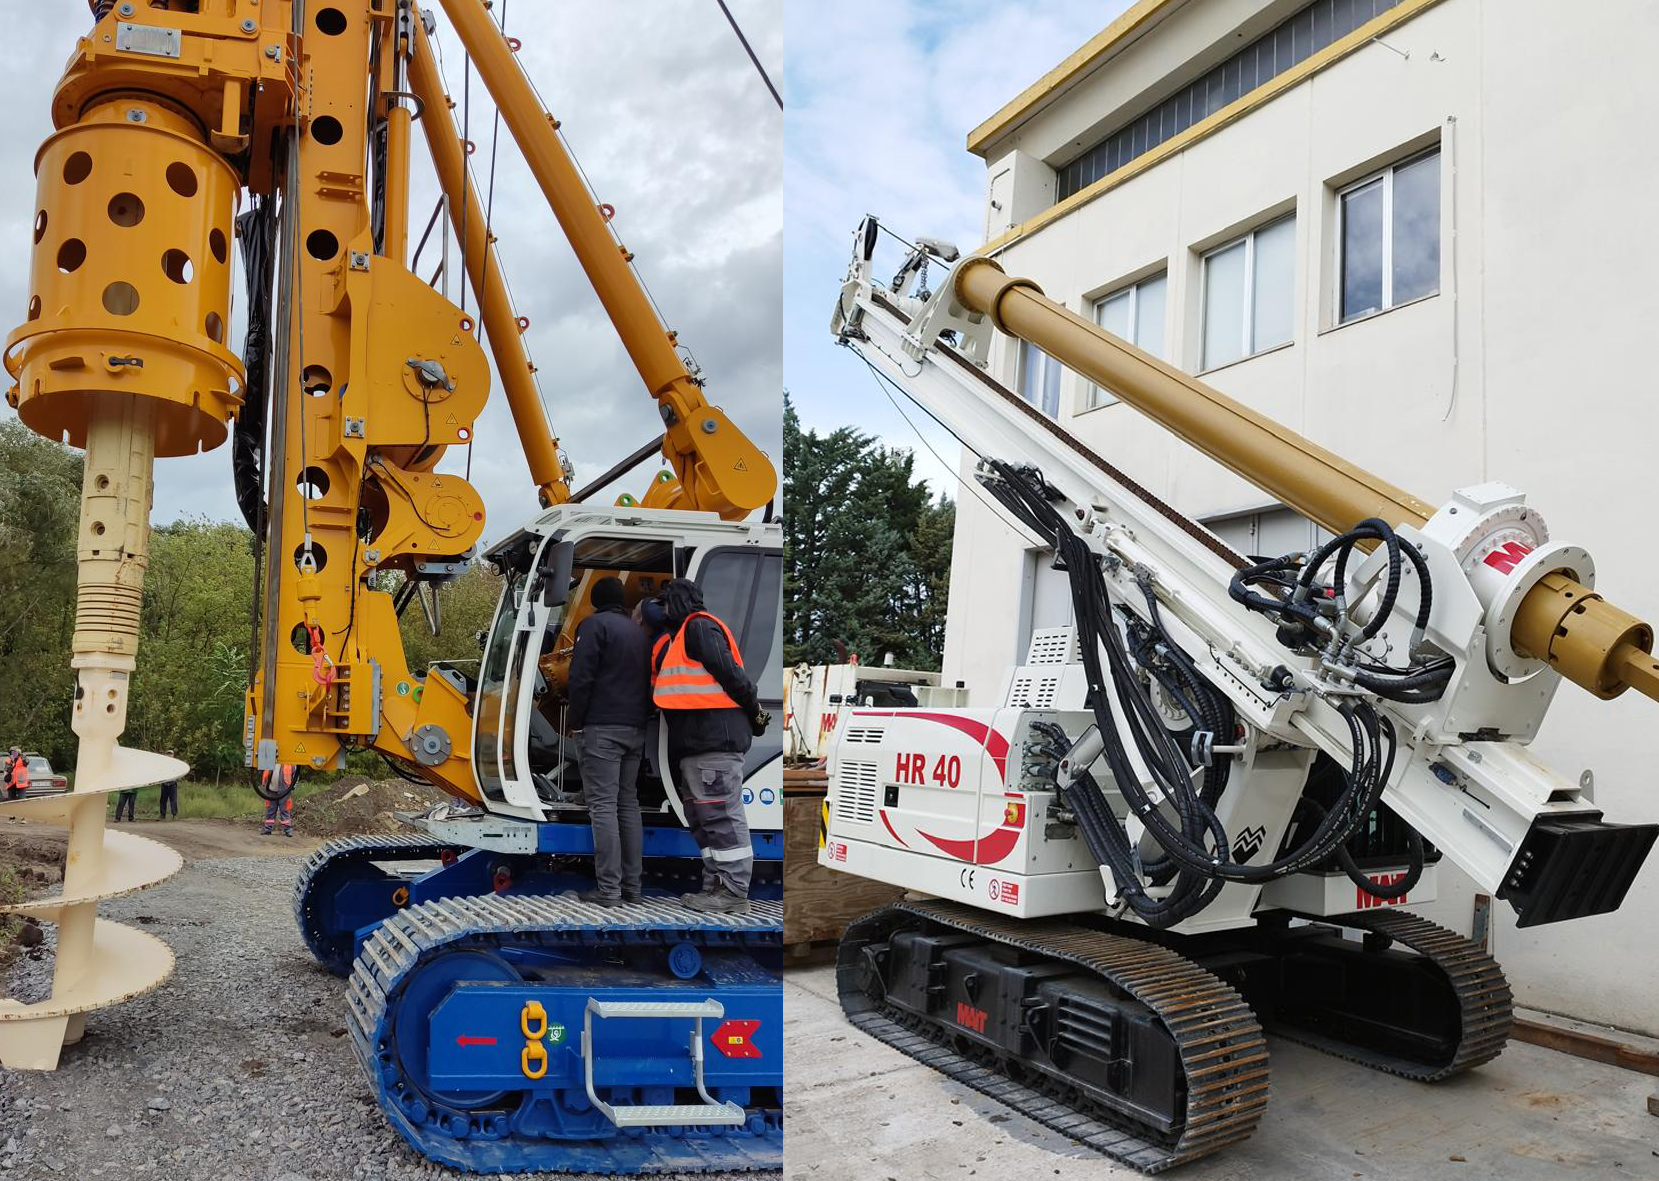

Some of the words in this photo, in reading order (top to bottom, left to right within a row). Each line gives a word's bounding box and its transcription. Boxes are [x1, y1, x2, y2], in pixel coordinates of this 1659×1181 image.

[895, 752, 926, 786] HR
[932, 754, 961, 789] 40
[960, 868, 975, 890] CE
